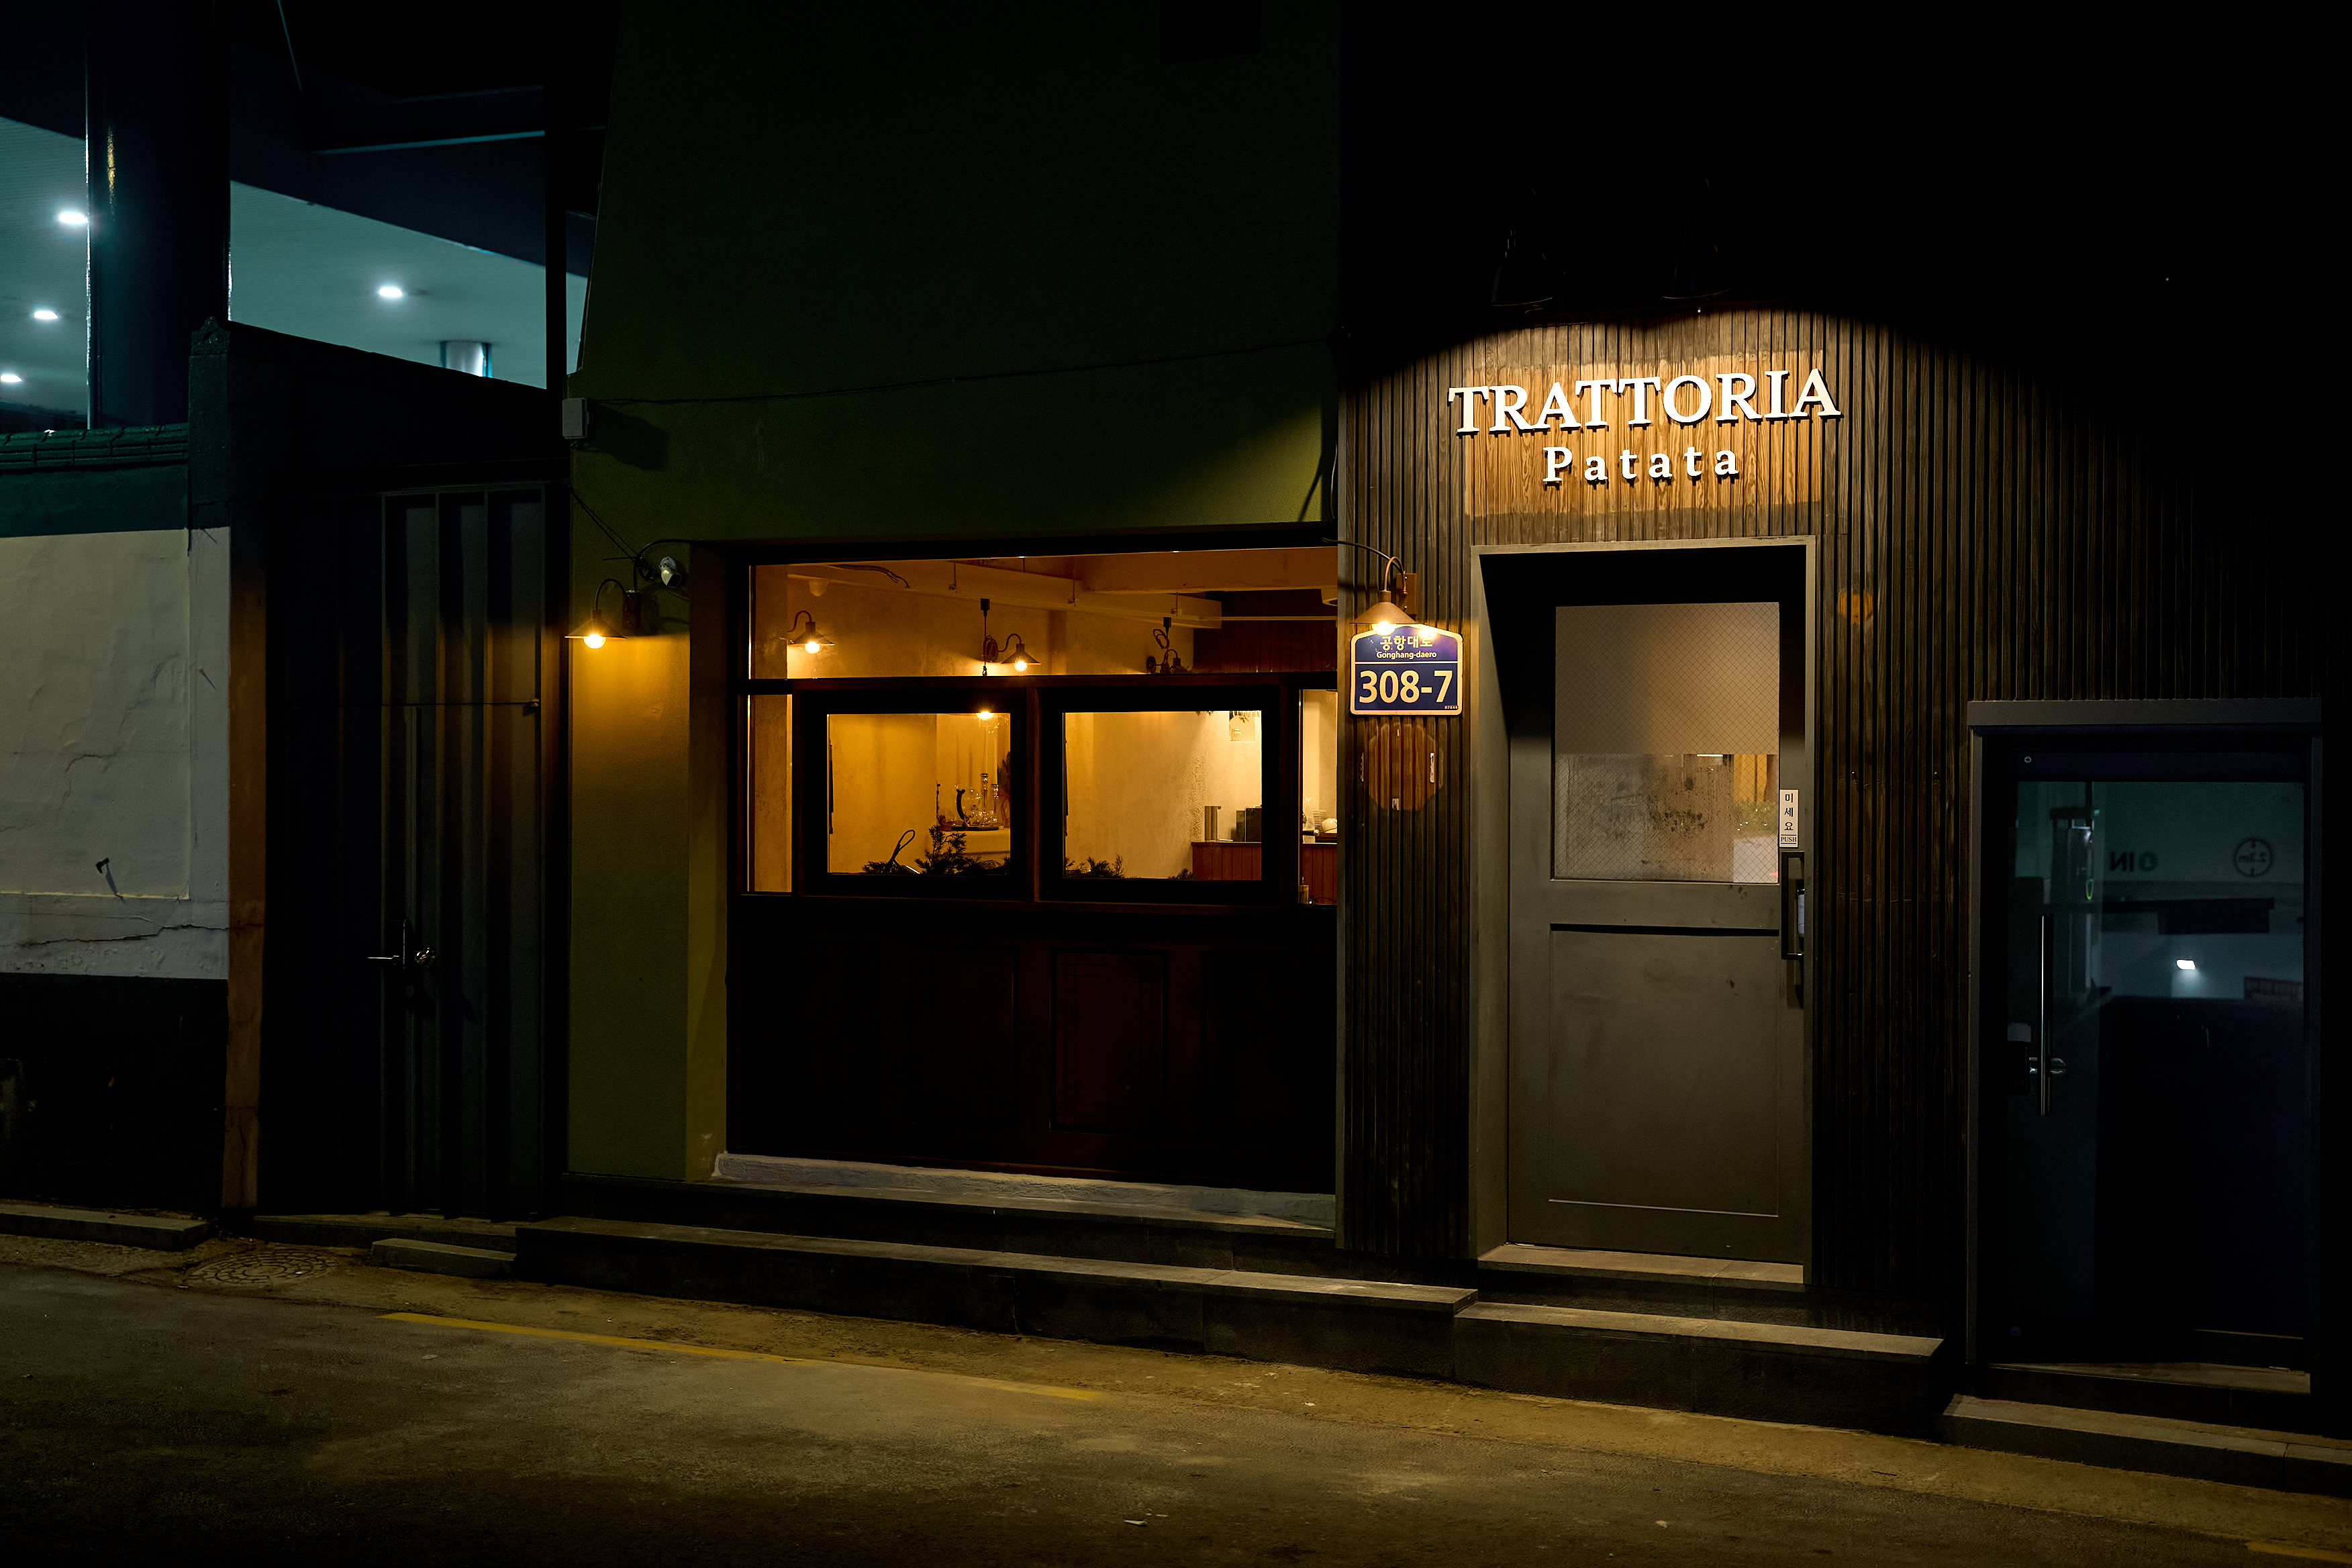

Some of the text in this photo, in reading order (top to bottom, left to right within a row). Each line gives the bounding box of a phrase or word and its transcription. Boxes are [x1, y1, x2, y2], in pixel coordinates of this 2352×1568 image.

[1448, 369, 1842, 434] TRATTORIA
[1542, 446, 1739, 483] Patata
[1376, 651, 1437, 660] Gonghang-daero
[1359, 670, 1453, 703] 308-7
[1784, 793, 1794, 831] 미세요
